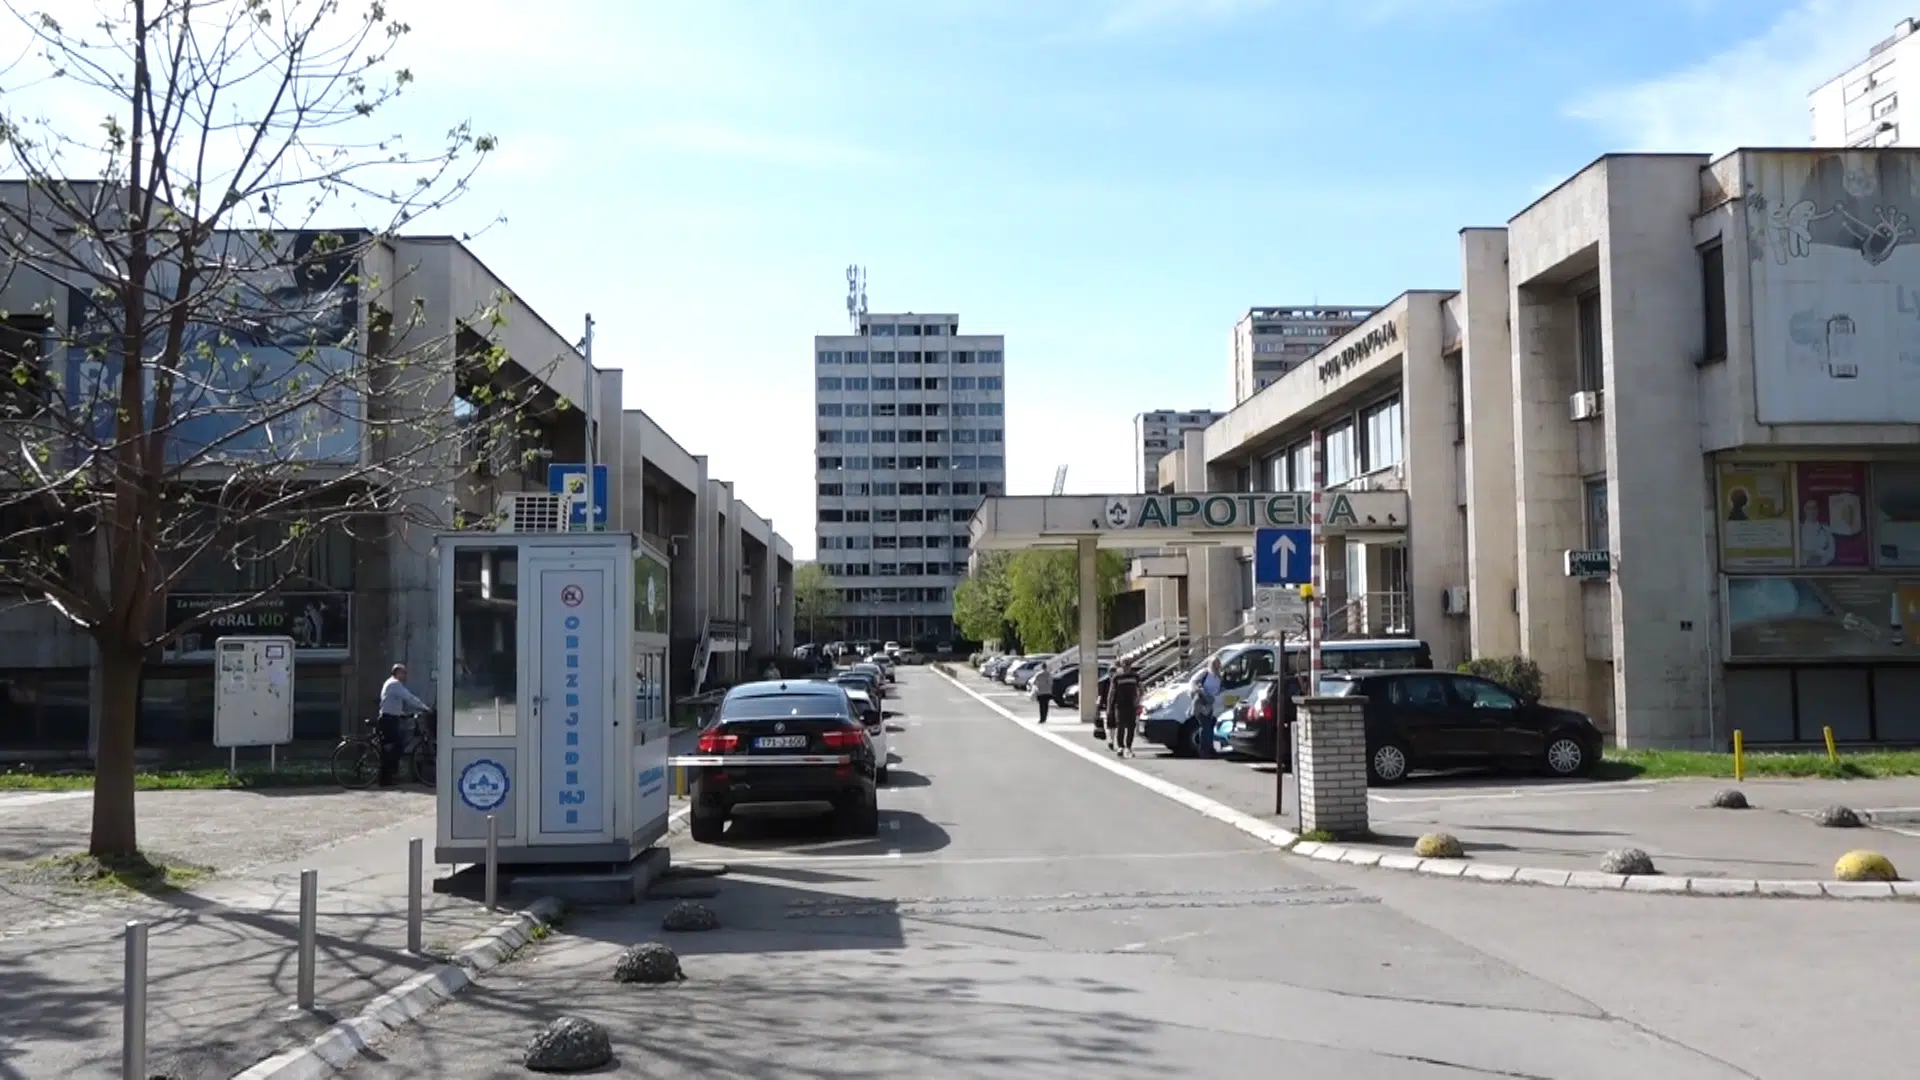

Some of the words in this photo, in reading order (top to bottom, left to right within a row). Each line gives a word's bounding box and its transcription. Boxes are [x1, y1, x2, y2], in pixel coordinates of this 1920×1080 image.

[1319, 355, 1341, 383] DOM
[1138, 496, 1358, 528] APOTEKA
[1571, 551, 1608, 561] APOTEKA
[258, 612, 284, 626] KID
